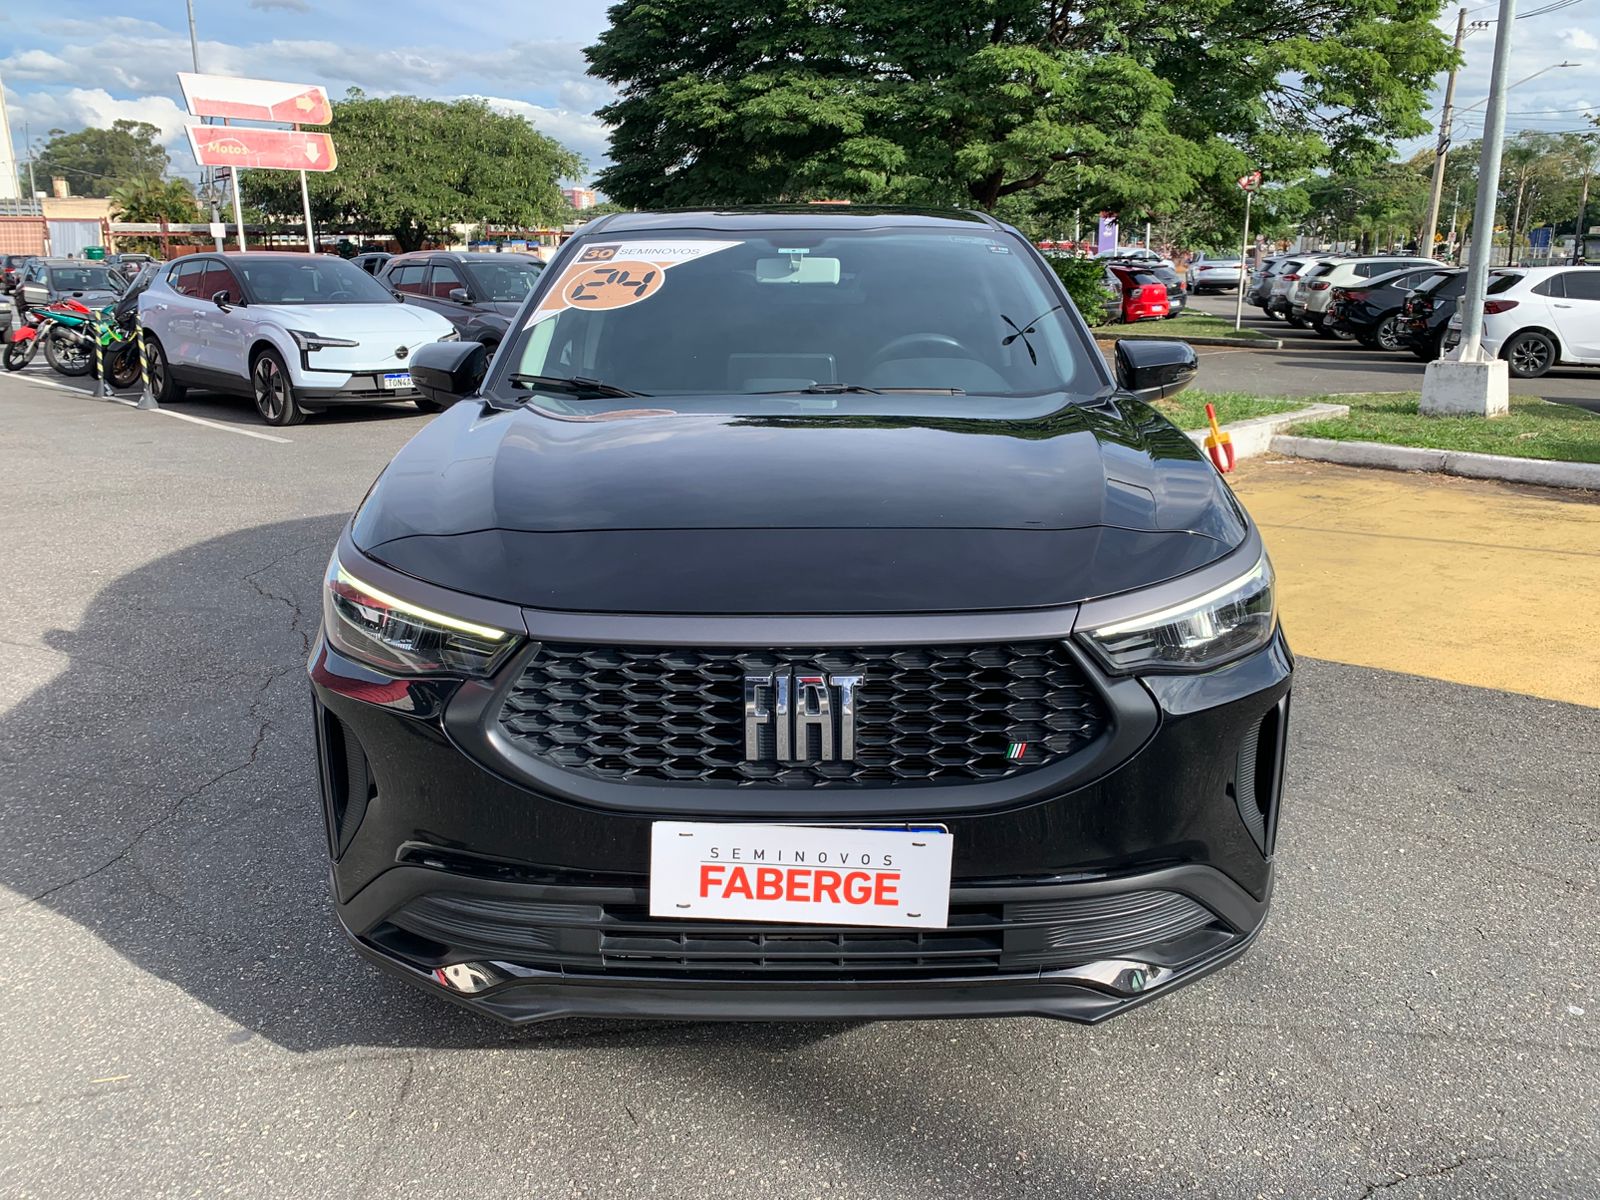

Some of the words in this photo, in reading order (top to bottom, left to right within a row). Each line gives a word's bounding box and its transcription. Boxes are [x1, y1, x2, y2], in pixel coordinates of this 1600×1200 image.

[208, 142, 248, 154] Motos
[583, 248, 615, 260] 30
[571, 268, 656, 300] 24
[744, 675, 865, 761] FIAT
[710, 847, 892, 866] SEMINOVOS
[699, 864, 901, 906] FABERGE
